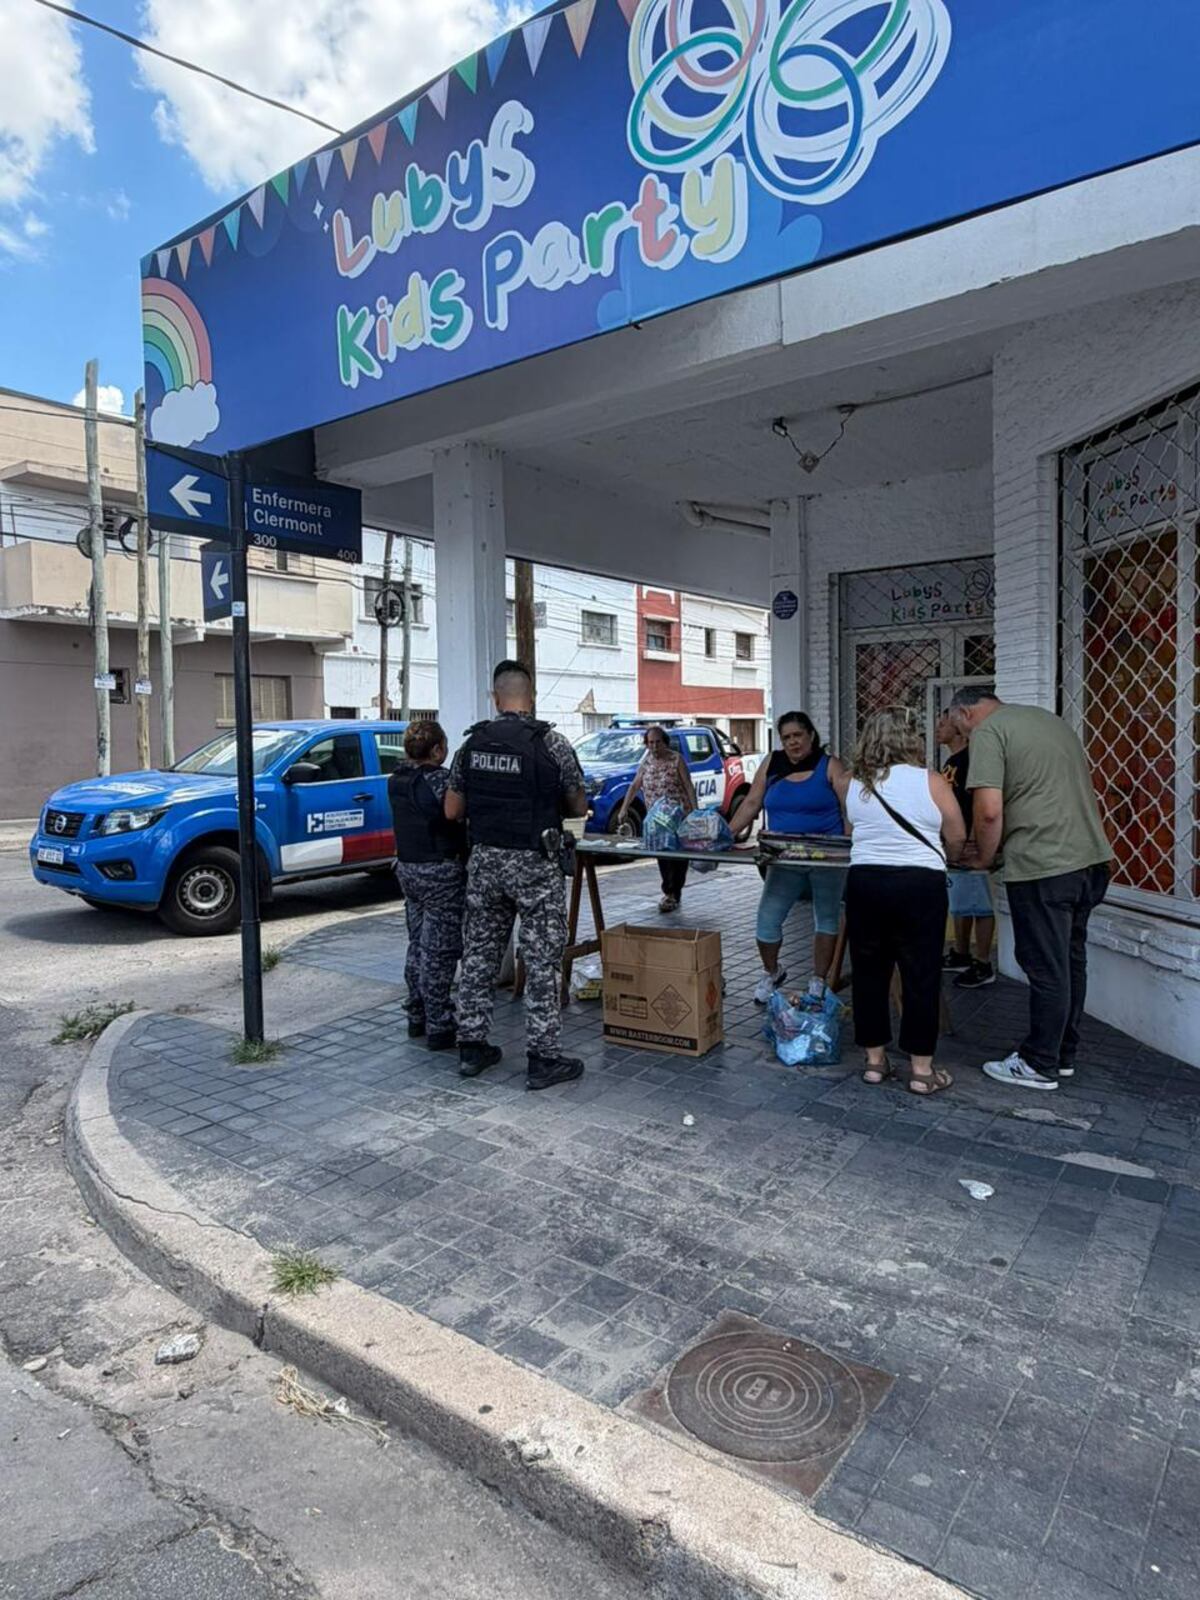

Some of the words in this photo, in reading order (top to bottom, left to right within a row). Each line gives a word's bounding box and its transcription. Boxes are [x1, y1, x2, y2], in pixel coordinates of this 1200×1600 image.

[483, 153, 748, 330] Party
[252, 487, 332, 518] Enfermera
[253, 508, 323, 535] Clermont
[253, 533, 277, 548] 300
[336, 549, 358, 562] 400
[471, 752, 521, 773] POLICIA
[694, 779, 717, 798] ICIA
